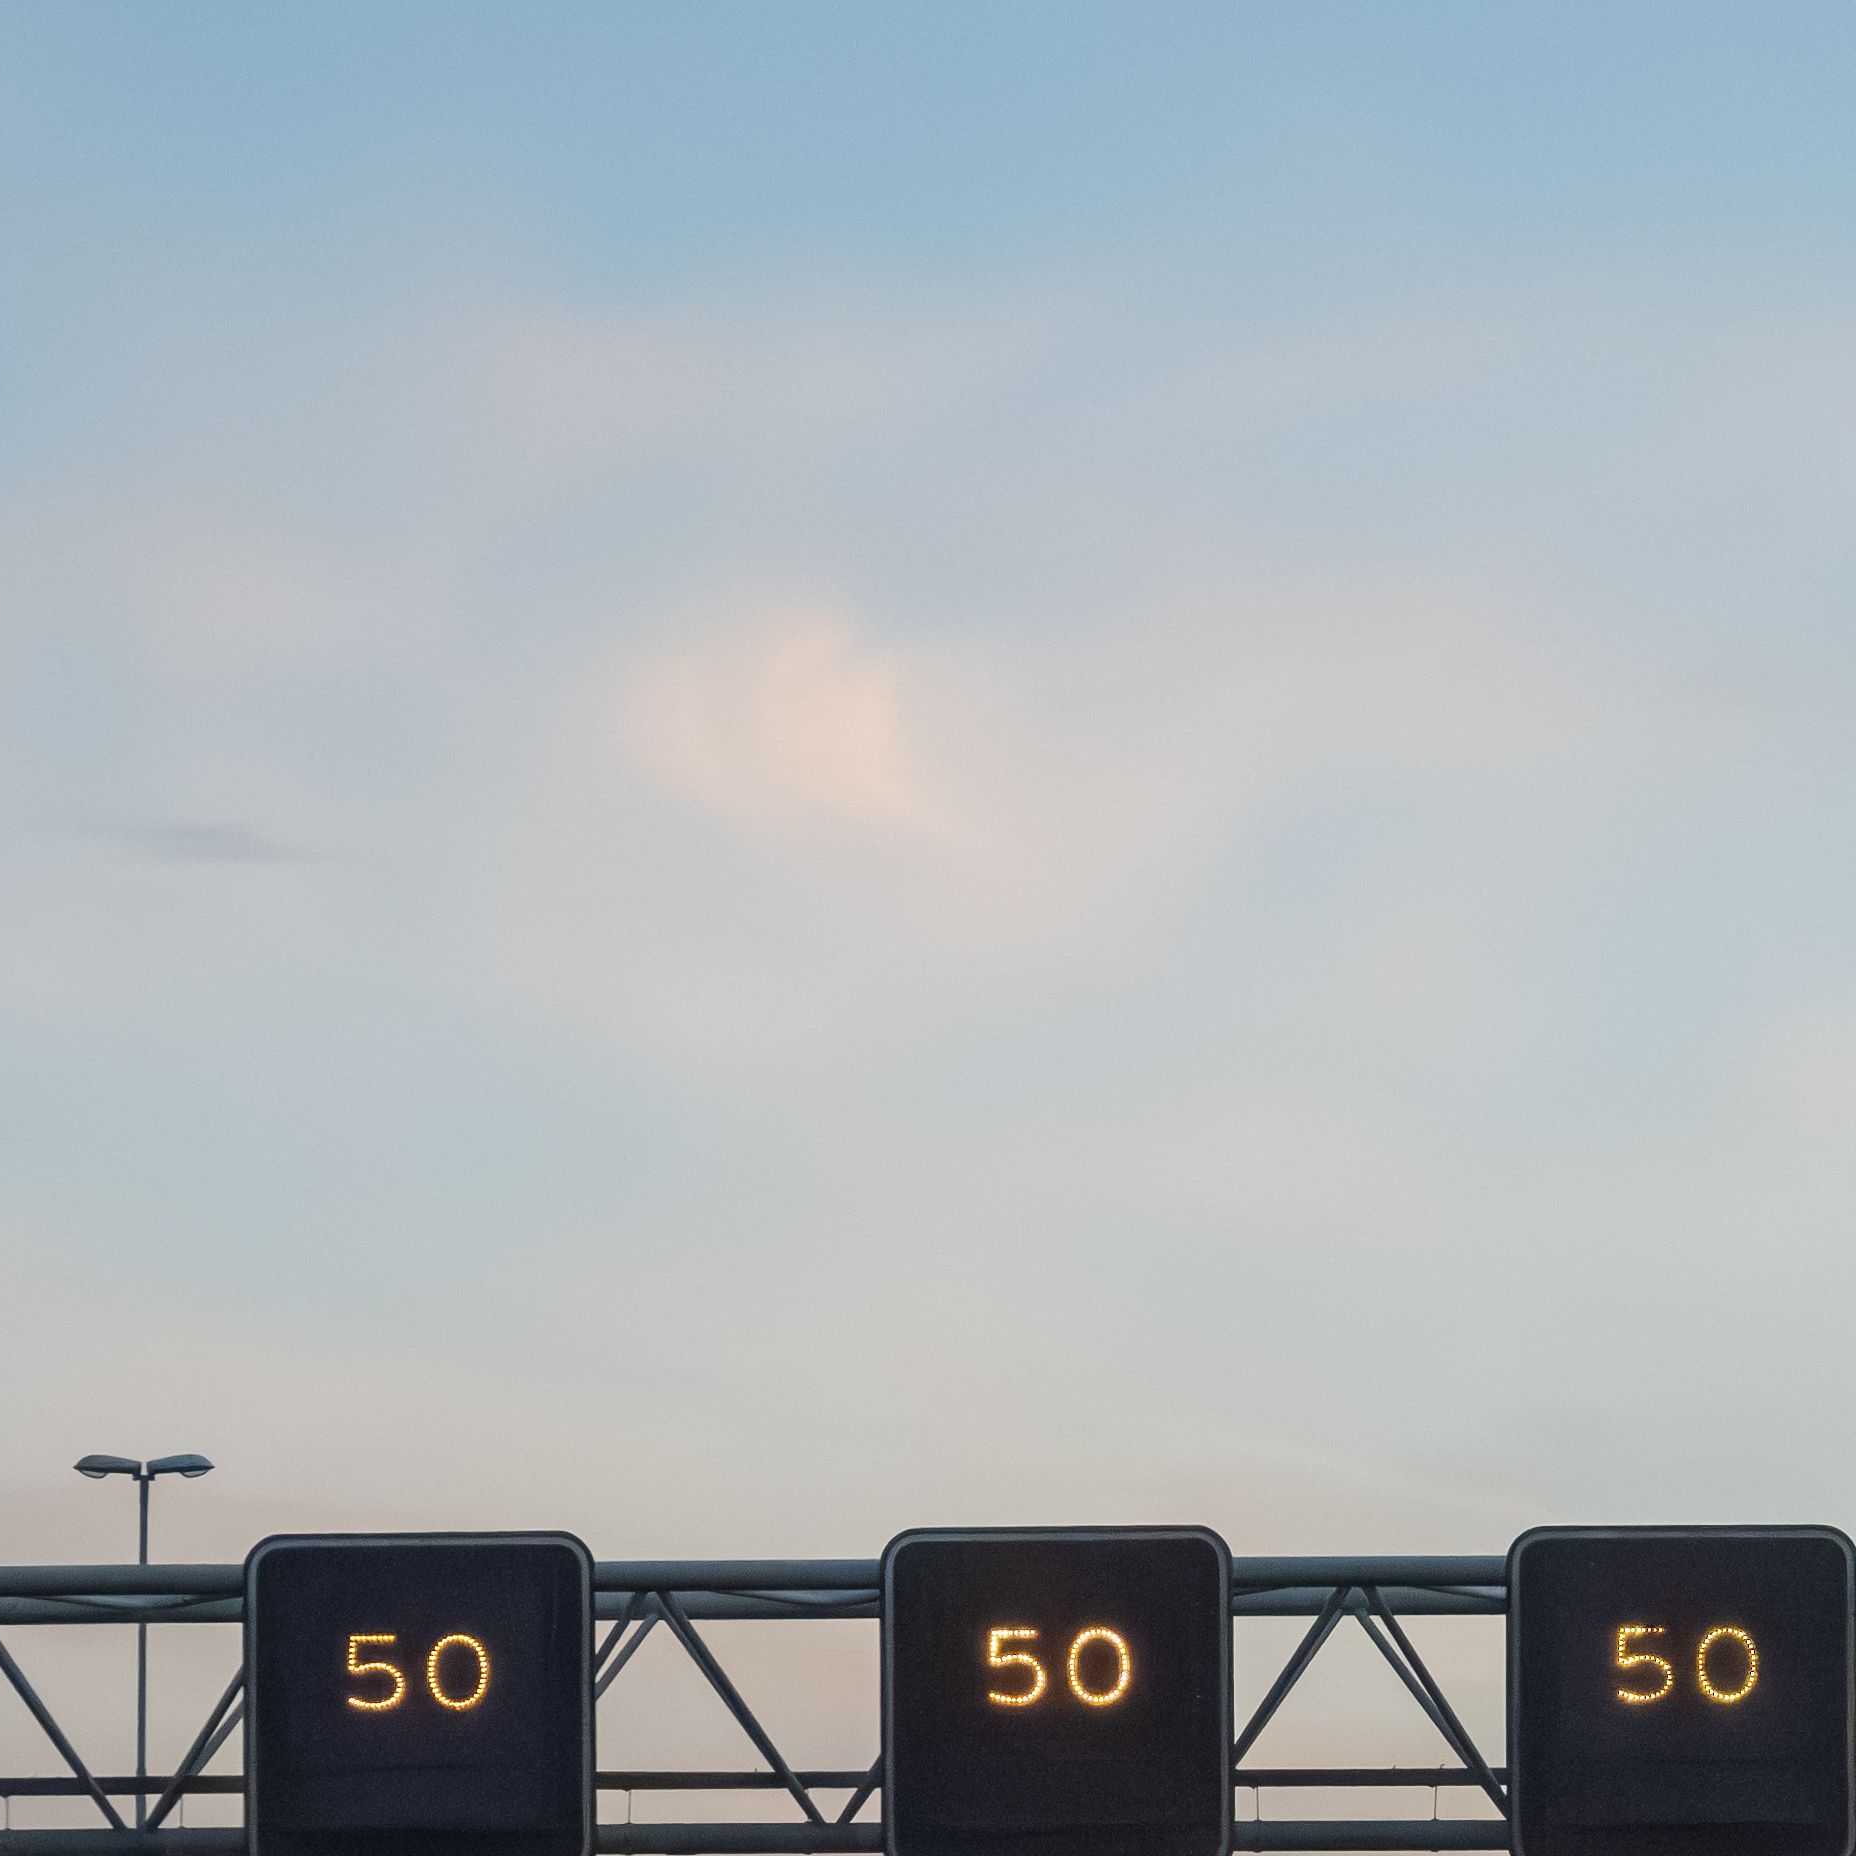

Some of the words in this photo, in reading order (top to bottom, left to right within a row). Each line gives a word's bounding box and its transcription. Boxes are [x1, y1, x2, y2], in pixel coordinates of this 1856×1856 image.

[346, 1632, 492, 1713] 50
[985, 1624, 1134, 1709] 50
[1614, 1623, 1761, 1706] 50
